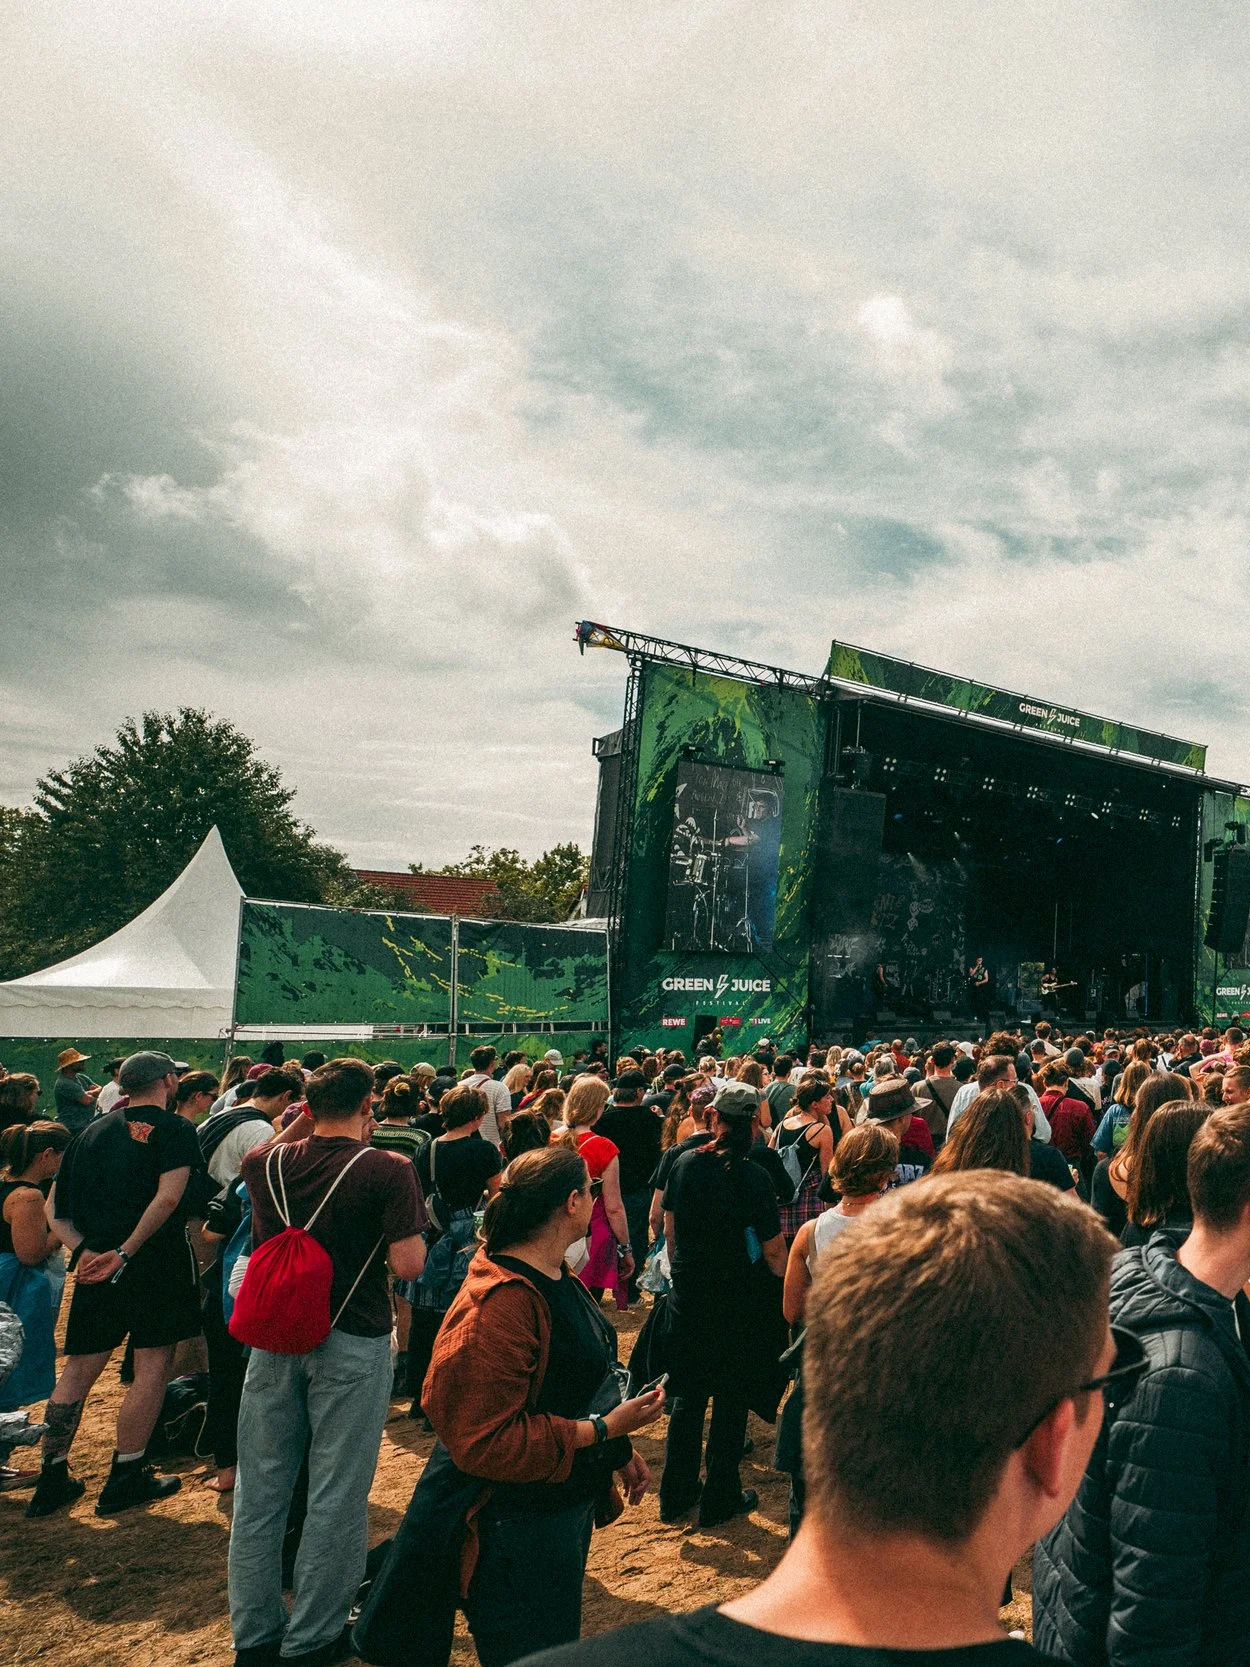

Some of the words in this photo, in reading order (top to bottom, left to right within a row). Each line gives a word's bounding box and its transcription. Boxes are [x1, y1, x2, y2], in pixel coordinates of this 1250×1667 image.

[1019, 703, 1048, 718] GREEN
[1057, 713, 1081, 727] JUICE
[662, 977, 713, 991] GREEN
[731, 979, 771, 992] JUICE
[1216, 987, 1240, 995] GREEN
[662, 1018, 686, 1026] REWE
